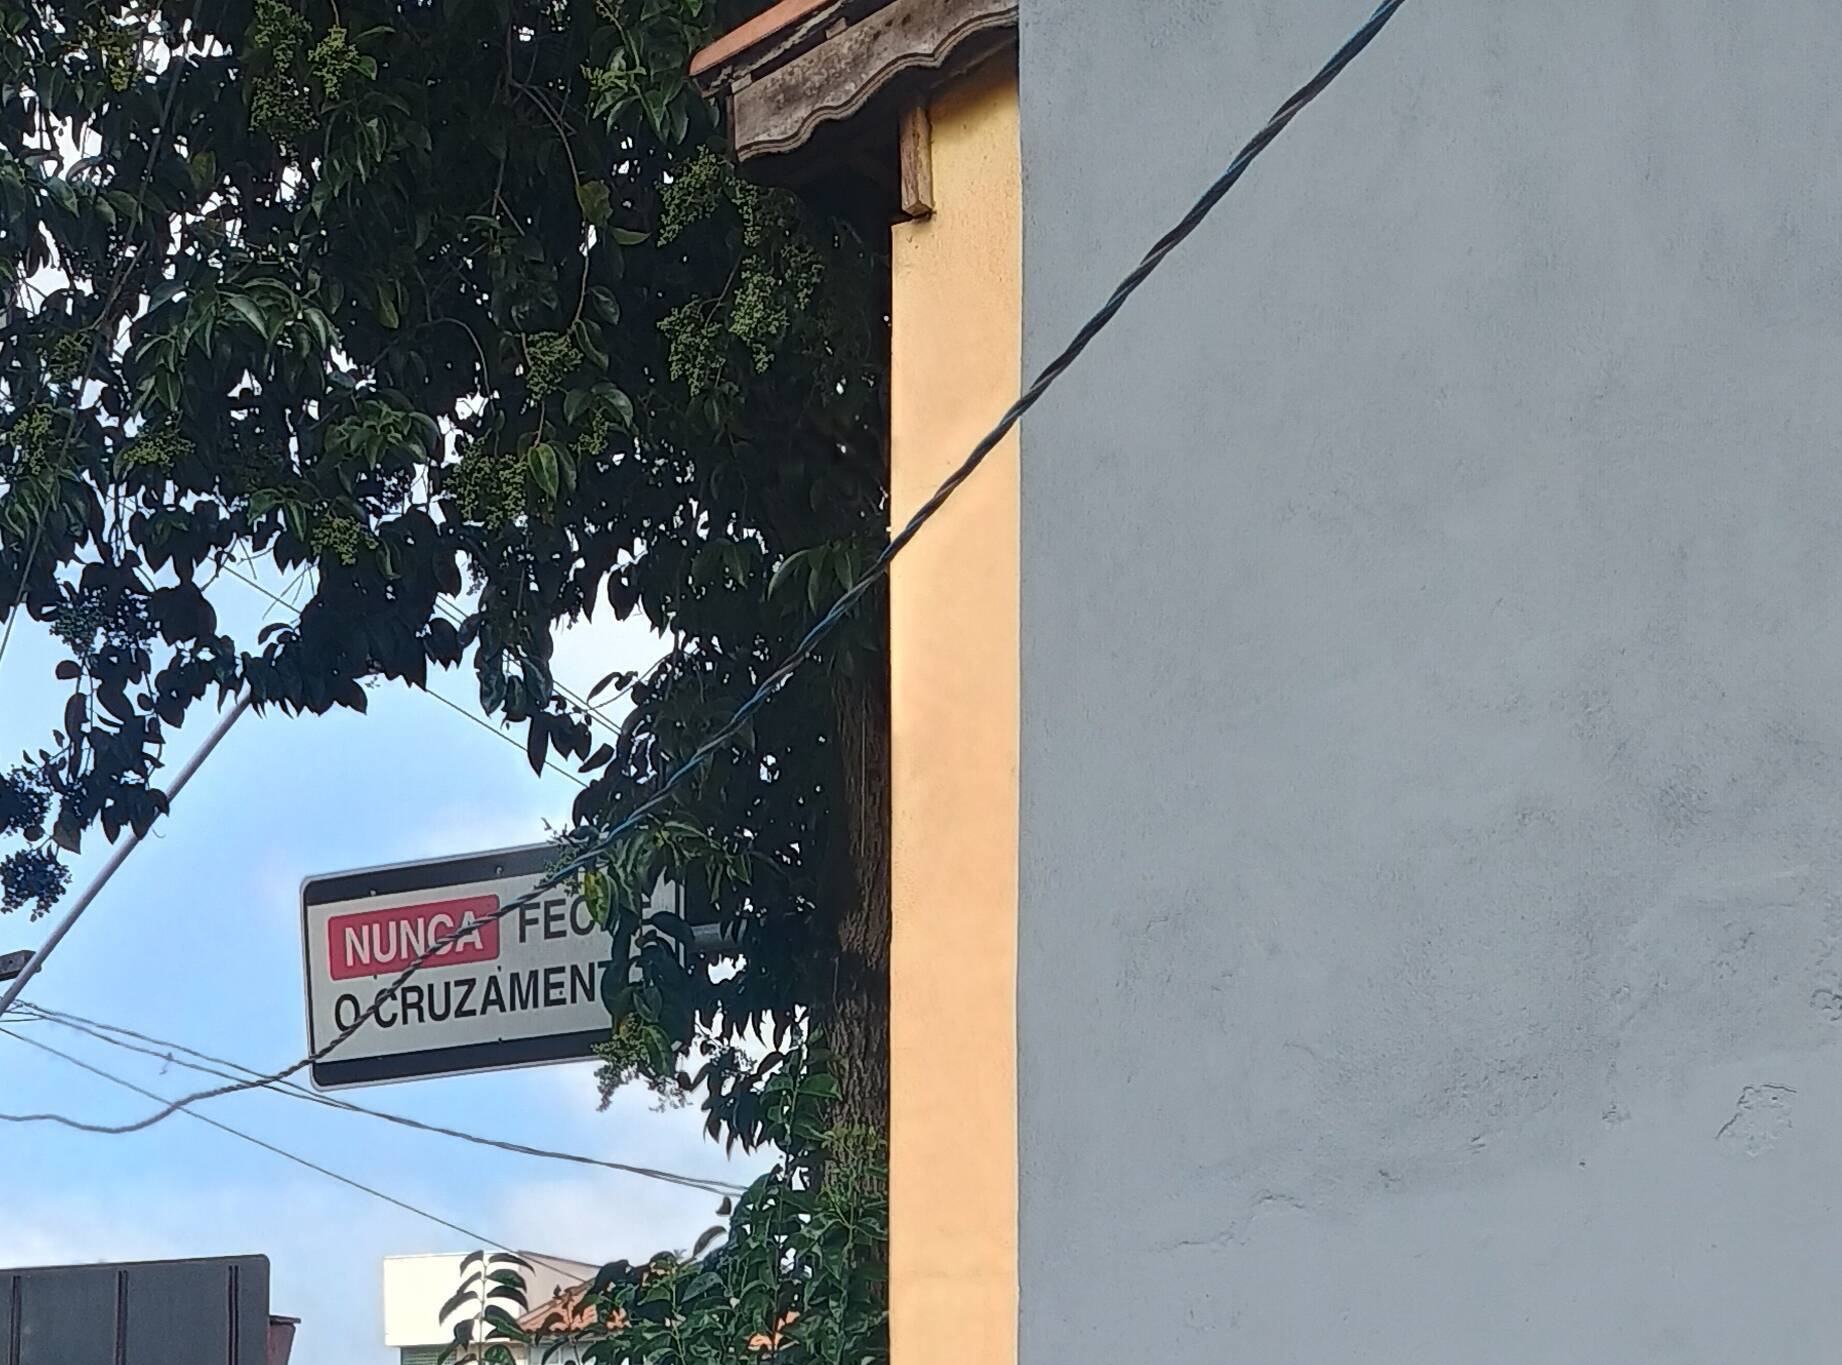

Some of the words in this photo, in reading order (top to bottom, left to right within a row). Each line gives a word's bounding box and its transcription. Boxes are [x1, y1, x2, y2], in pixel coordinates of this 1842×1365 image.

[344, 910, 484, 968] NUNCA
[518, 893, 653, 944] FEC
[334, 993, 362, 1033] O
[373, 959, 614, 1029] CRUZAMEN
